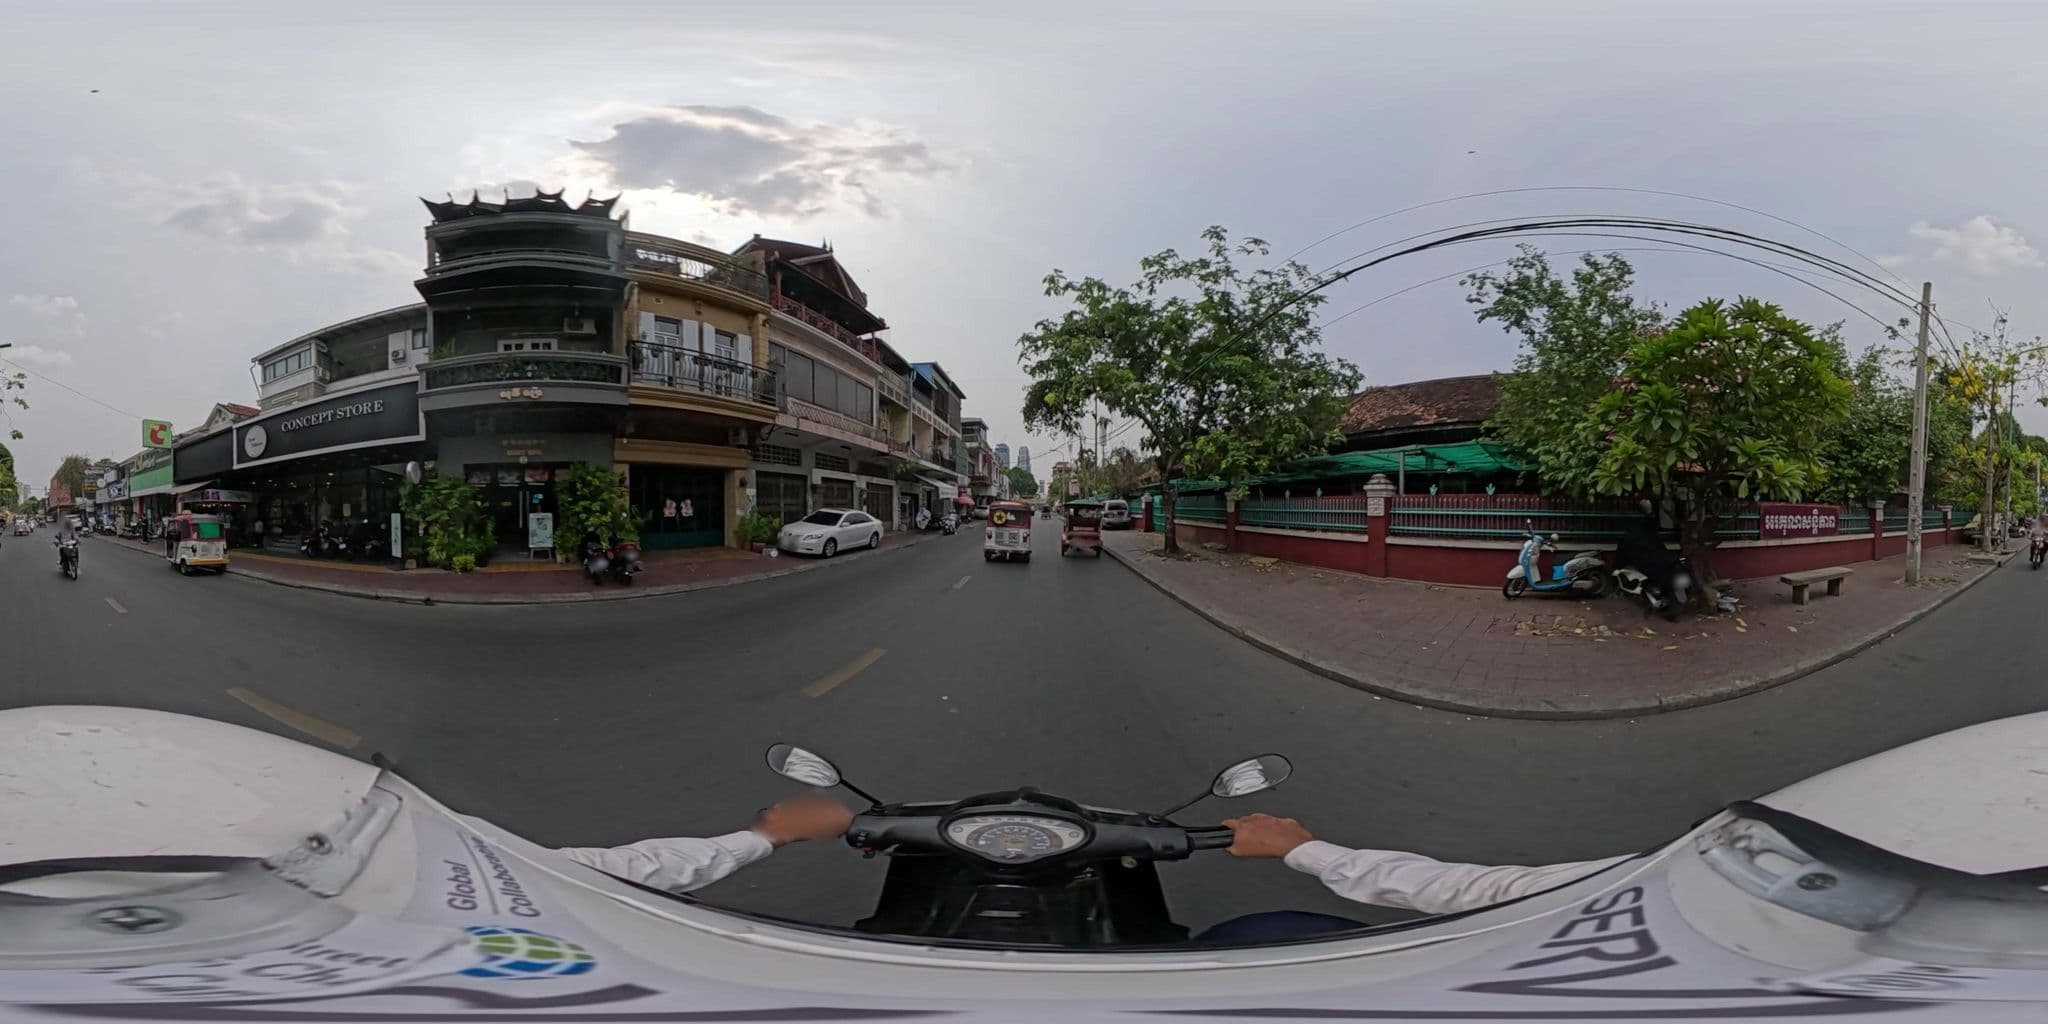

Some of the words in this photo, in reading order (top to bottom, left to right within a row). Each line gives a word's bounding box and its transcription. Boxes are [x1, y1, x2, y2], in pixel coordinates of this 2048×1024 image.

[281, 410, 334, 433] CONCEPT
[336, 399, 385, 420] STORE
[443, 859, 479, 911] Global
